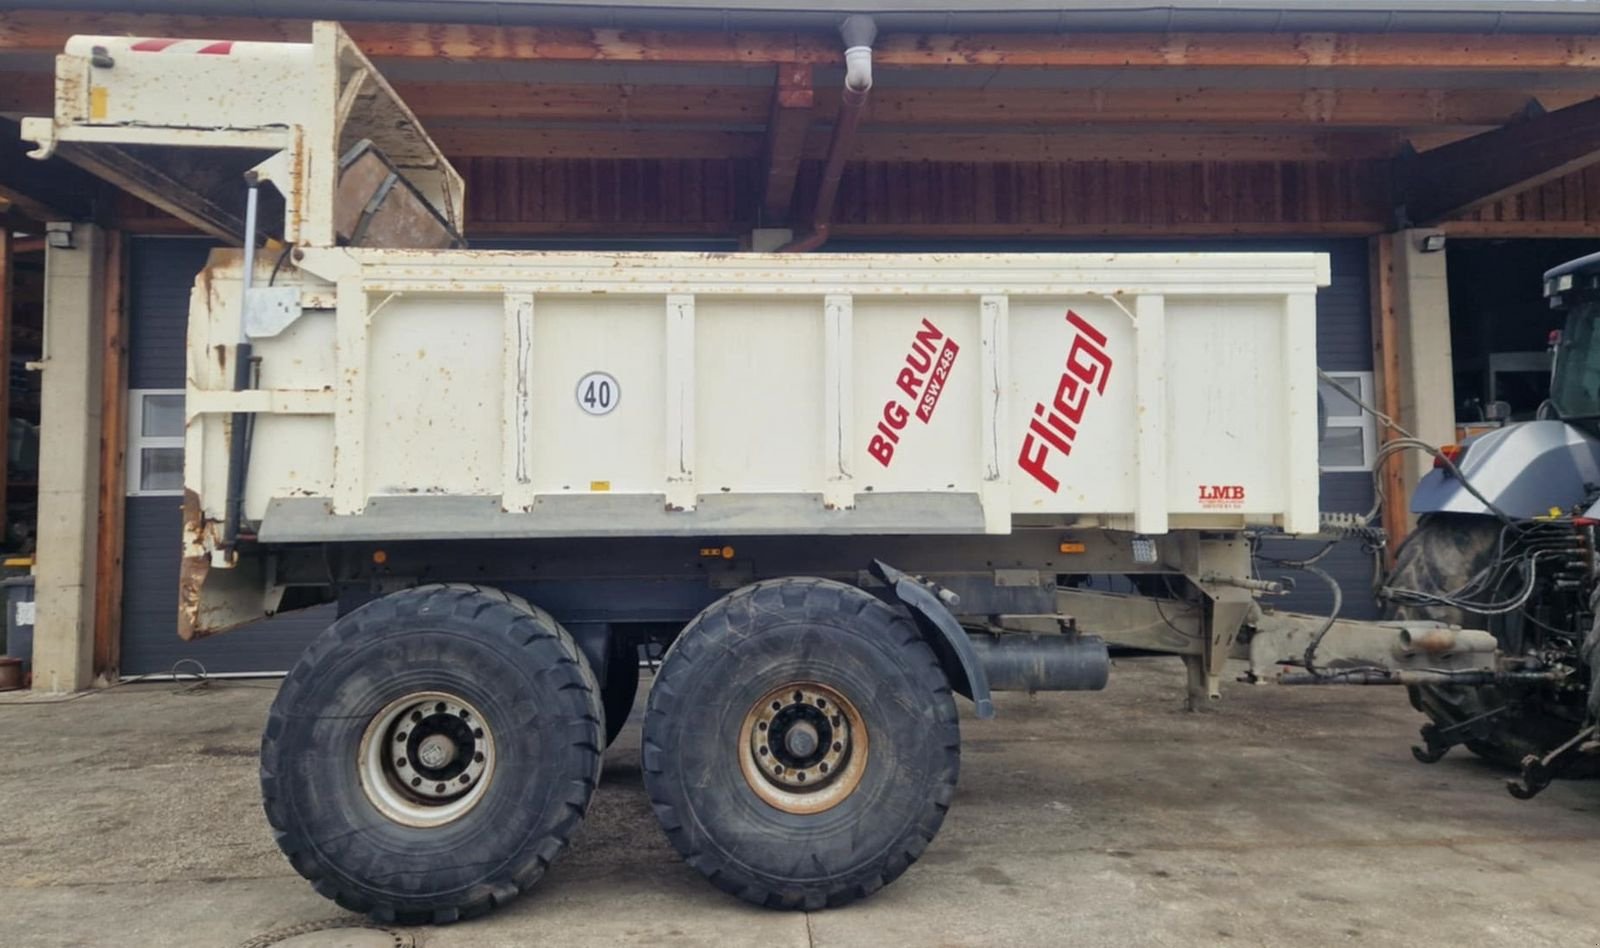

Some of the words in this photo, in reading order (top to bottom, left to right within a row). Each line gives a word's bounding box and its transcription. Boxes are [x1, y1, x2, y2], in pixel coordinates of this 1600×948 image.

[584, 380, 610, 408] 40
[867, 400, 910, 467] BIG
[896, 318, 944, 400] RUN
[921, 377, 941, 417] ASW
[935, 348, 955, 380] 248
[1018, 310, 1113, 493] Fliegl
[1198, 485, 1245, 499] LMB
